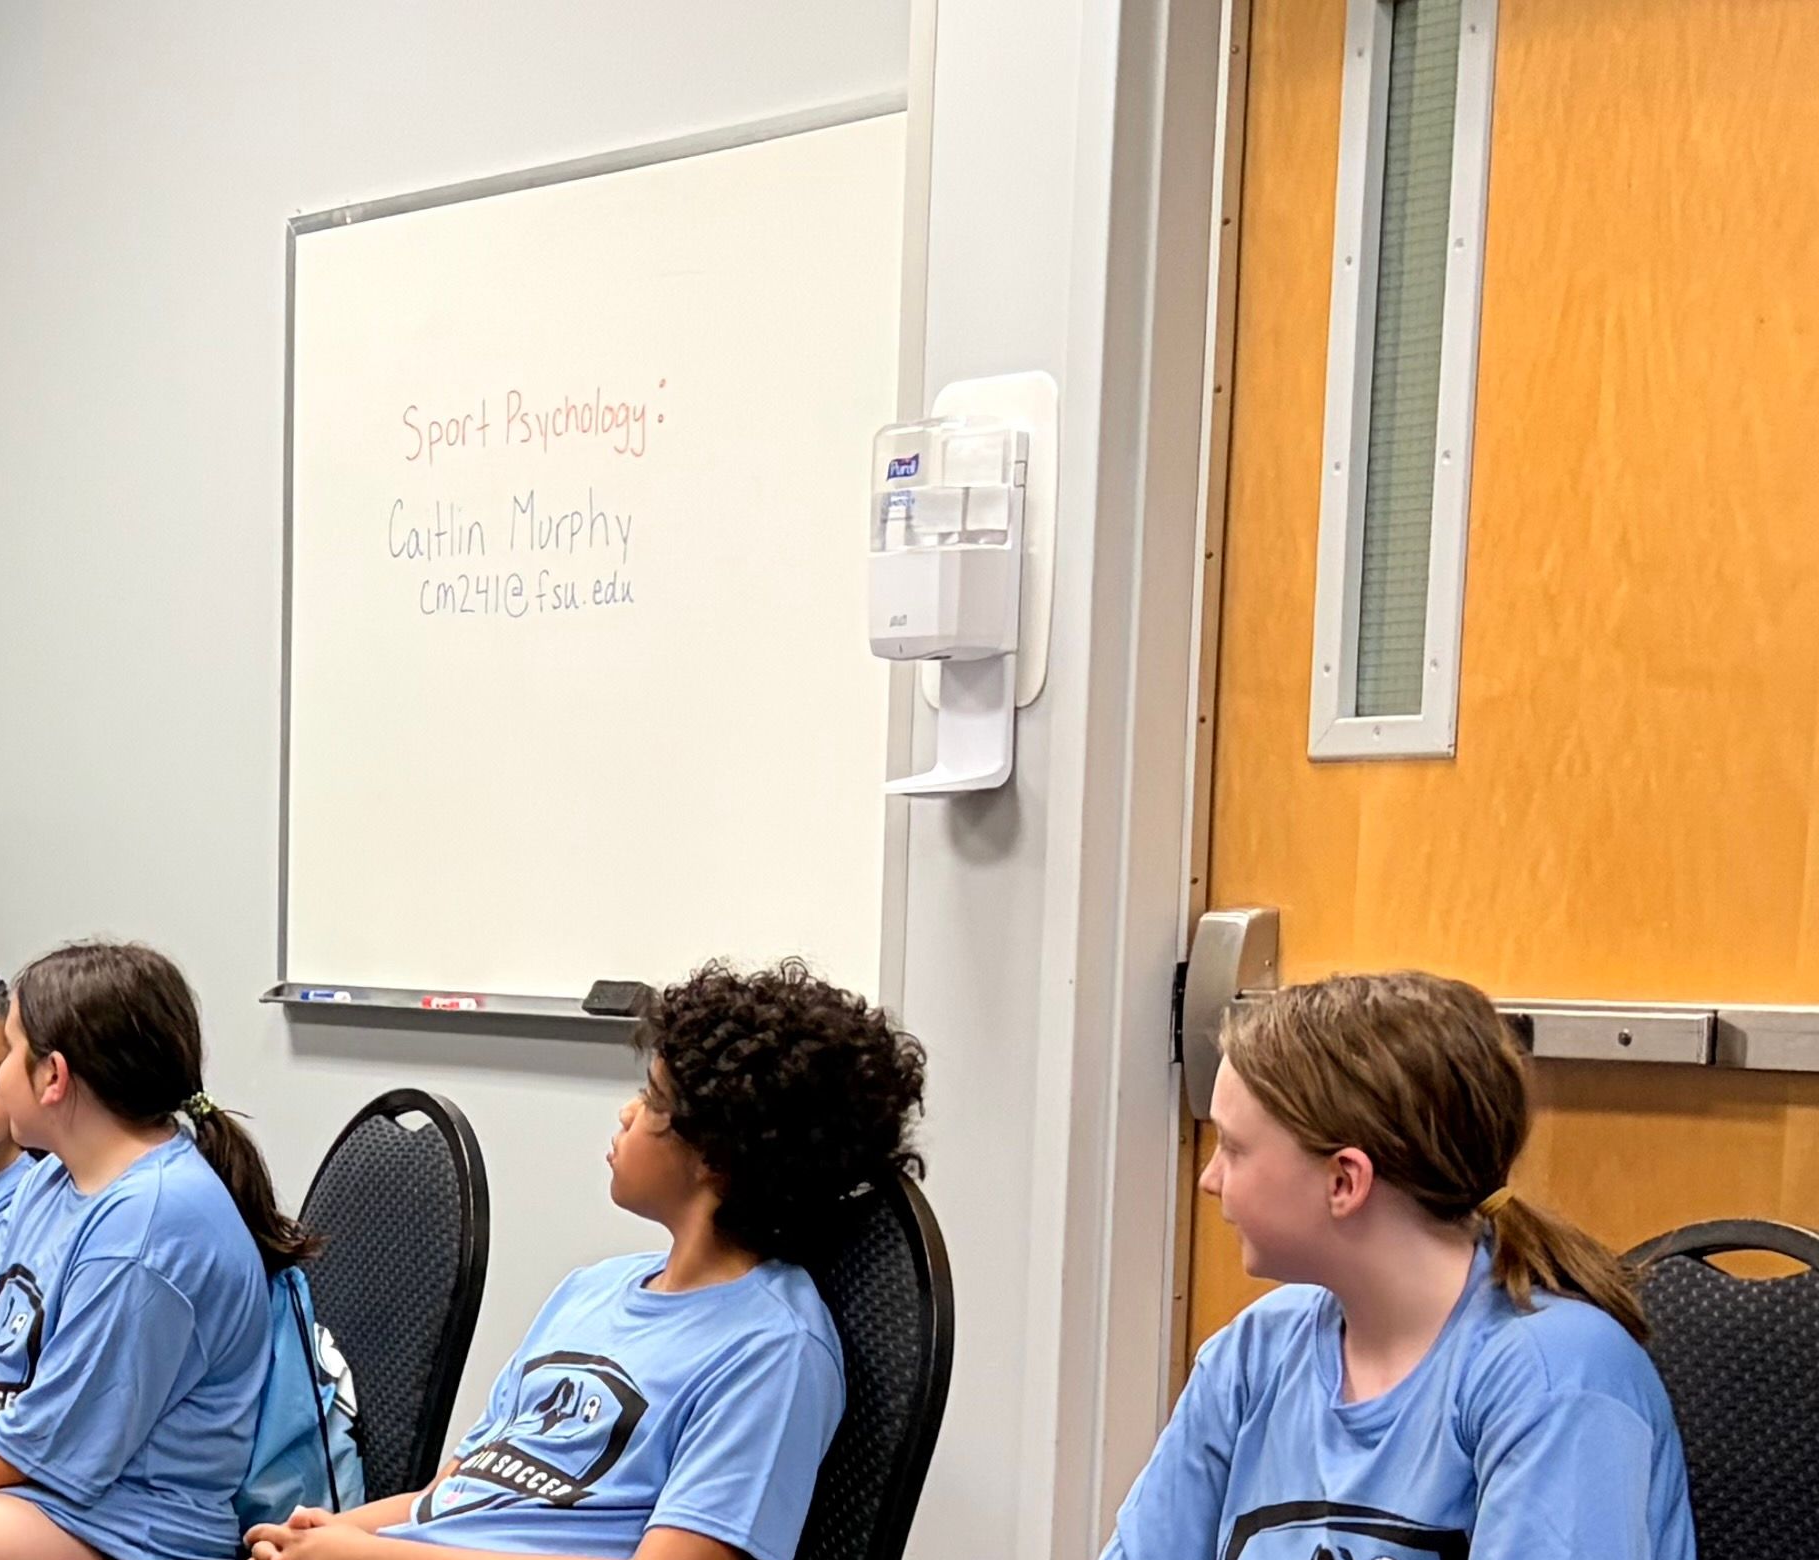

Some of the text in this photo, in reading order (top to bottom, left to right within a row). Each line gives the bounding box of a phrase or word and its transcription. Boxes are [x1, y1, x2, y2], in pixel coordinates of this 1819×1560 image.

[403, 405, 490, 467] Sport
[389, 486, 632, 564] Caitlin Murphy
[420, 569, 634, 618] cm241@fsu.edu
